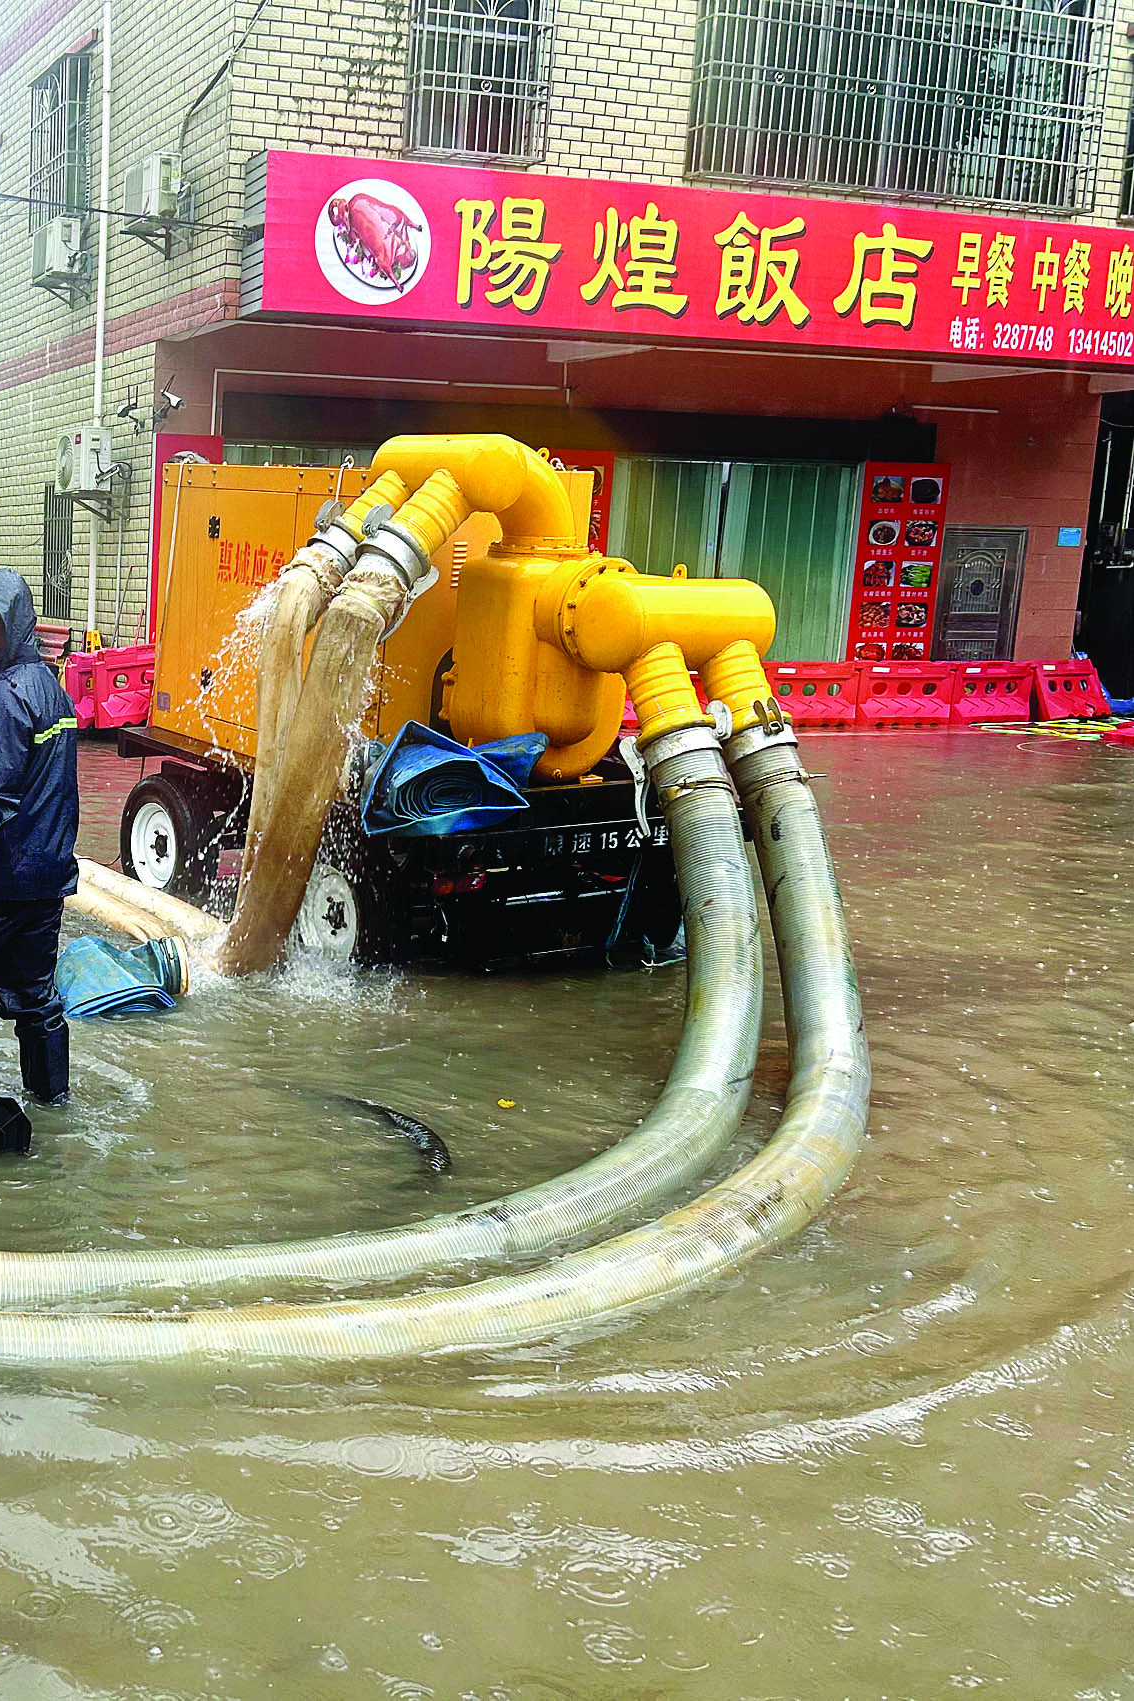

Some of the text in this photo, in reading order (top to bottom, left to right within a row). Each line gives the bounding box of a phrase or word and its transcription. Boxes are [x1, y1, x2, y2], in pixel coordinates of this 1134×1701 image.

[454, 196, 935, 330] 陽煌飯店
[951, 231, 1016, 309] 早餐
[1031, 236, 1092, 315] 中餐
[992, 322, 1054, 351] 3287748
[1068, 328, 1134, 357] 13414502
